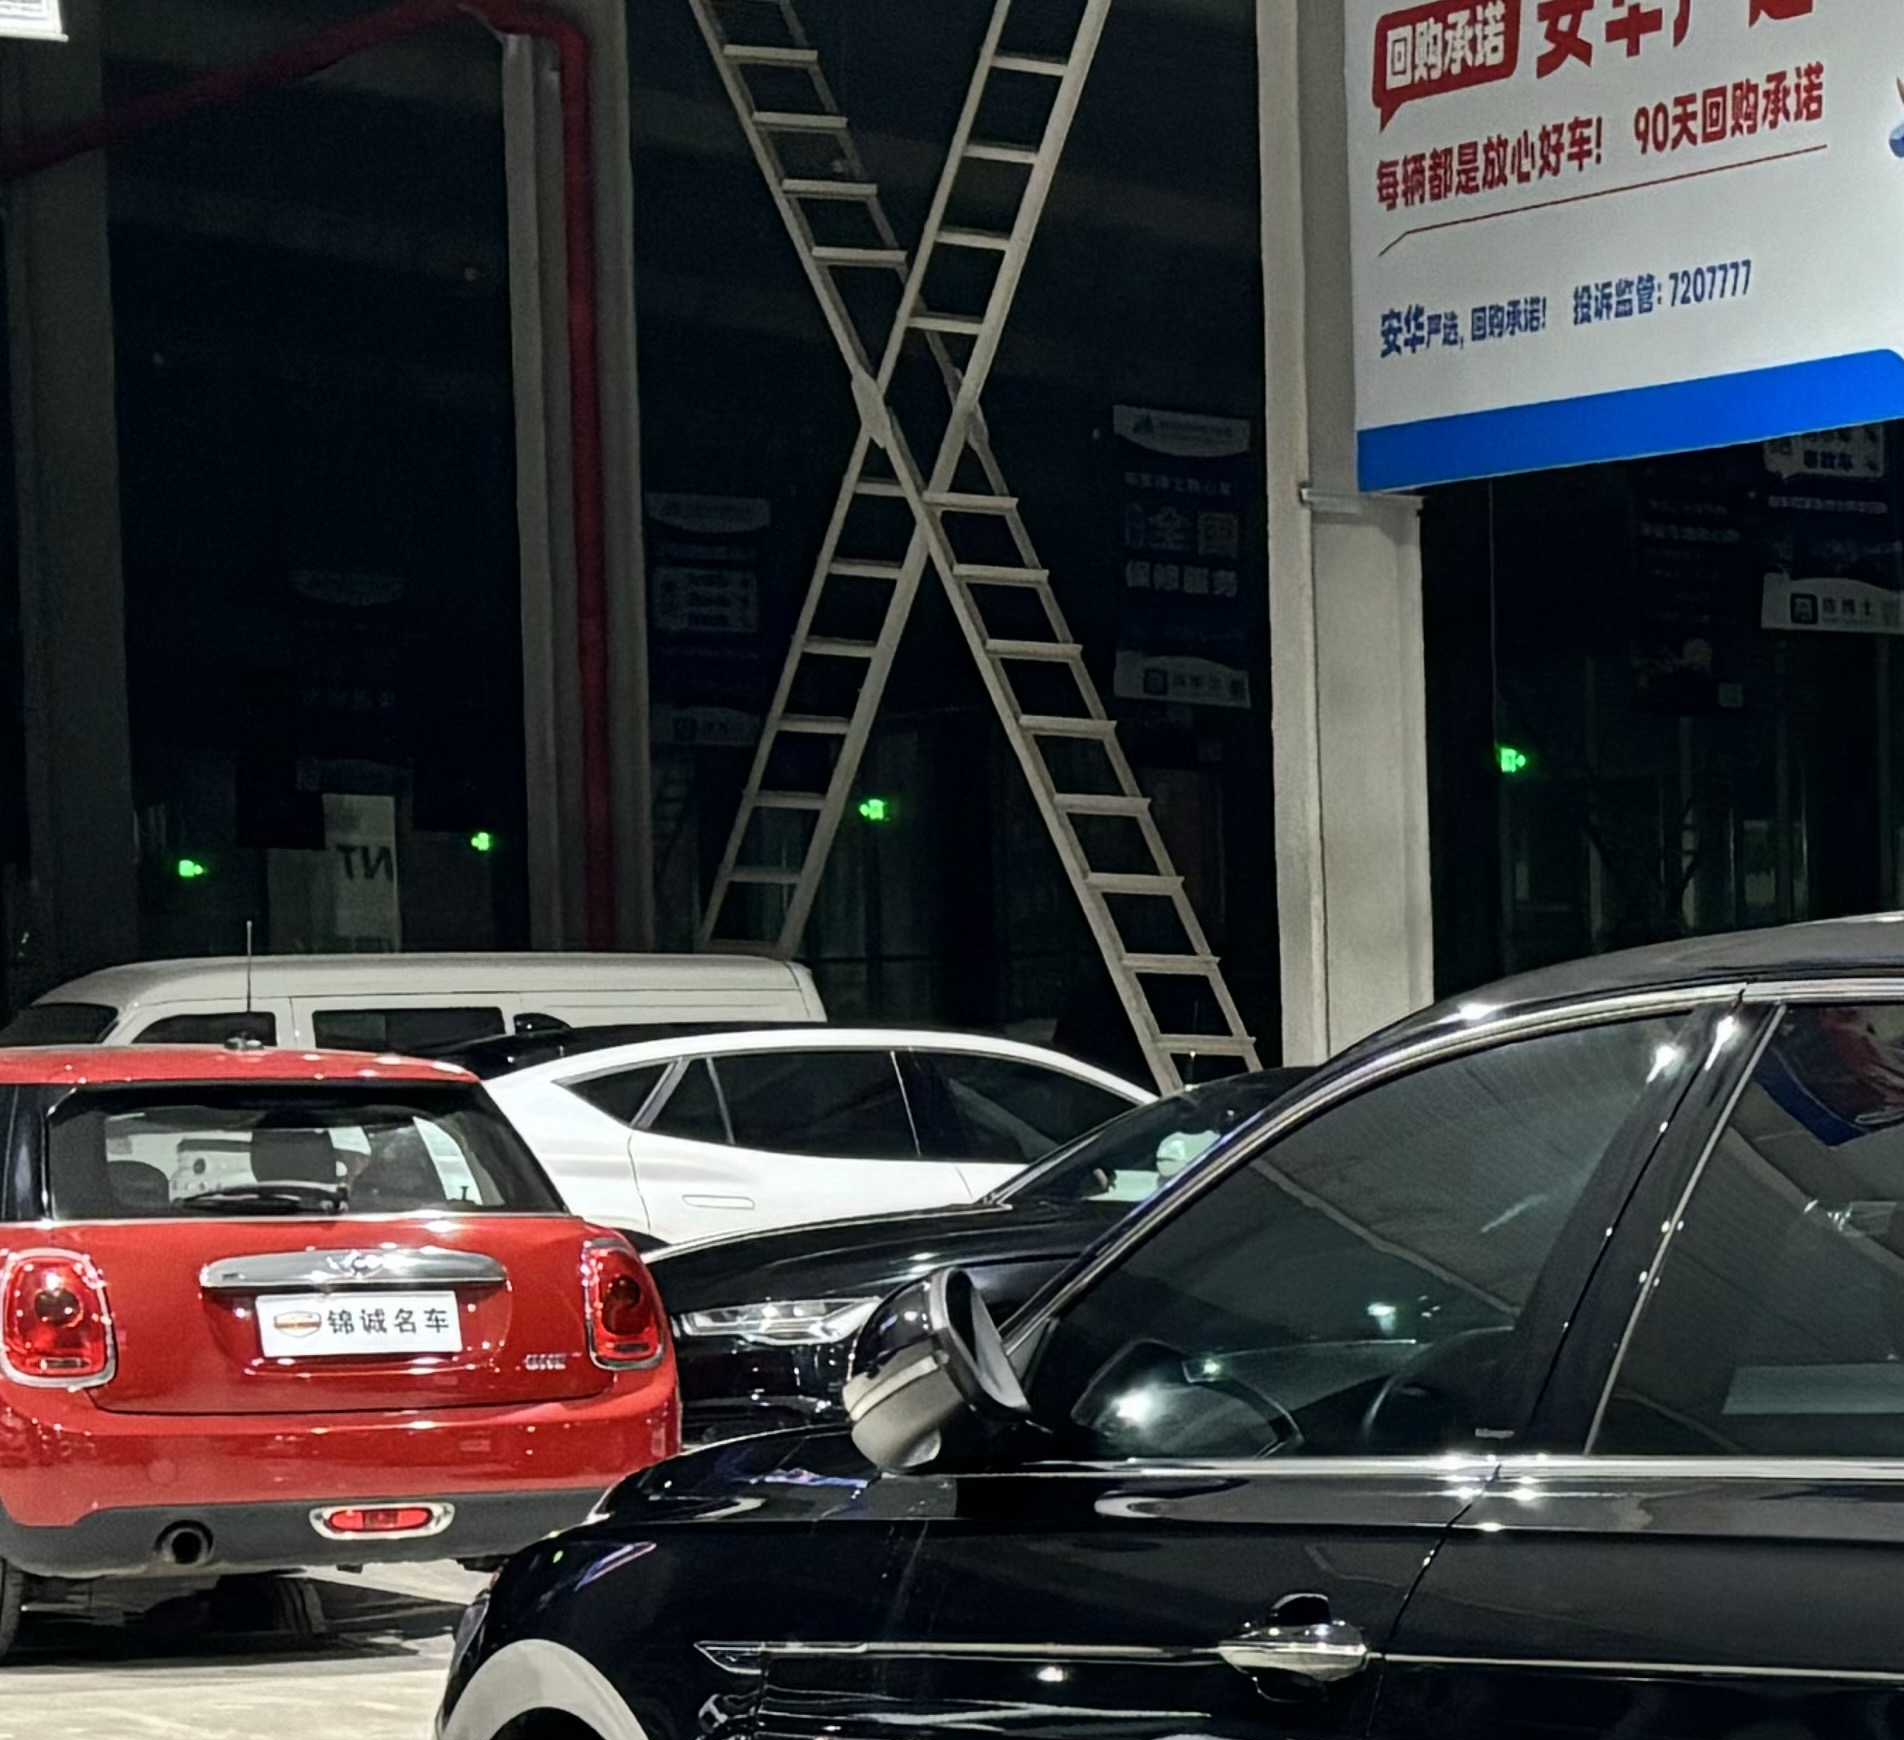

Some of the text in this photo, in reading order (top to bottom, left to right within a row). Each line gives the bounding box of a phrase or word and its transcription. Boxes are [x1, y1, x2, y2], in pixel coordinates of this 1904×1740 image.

[1385, 3, 1505, 90] 回购承诺
[1633, 62, 1825, 155] 90天回购承诺
[327, 1307, 450, 1335] 锦诚名车
